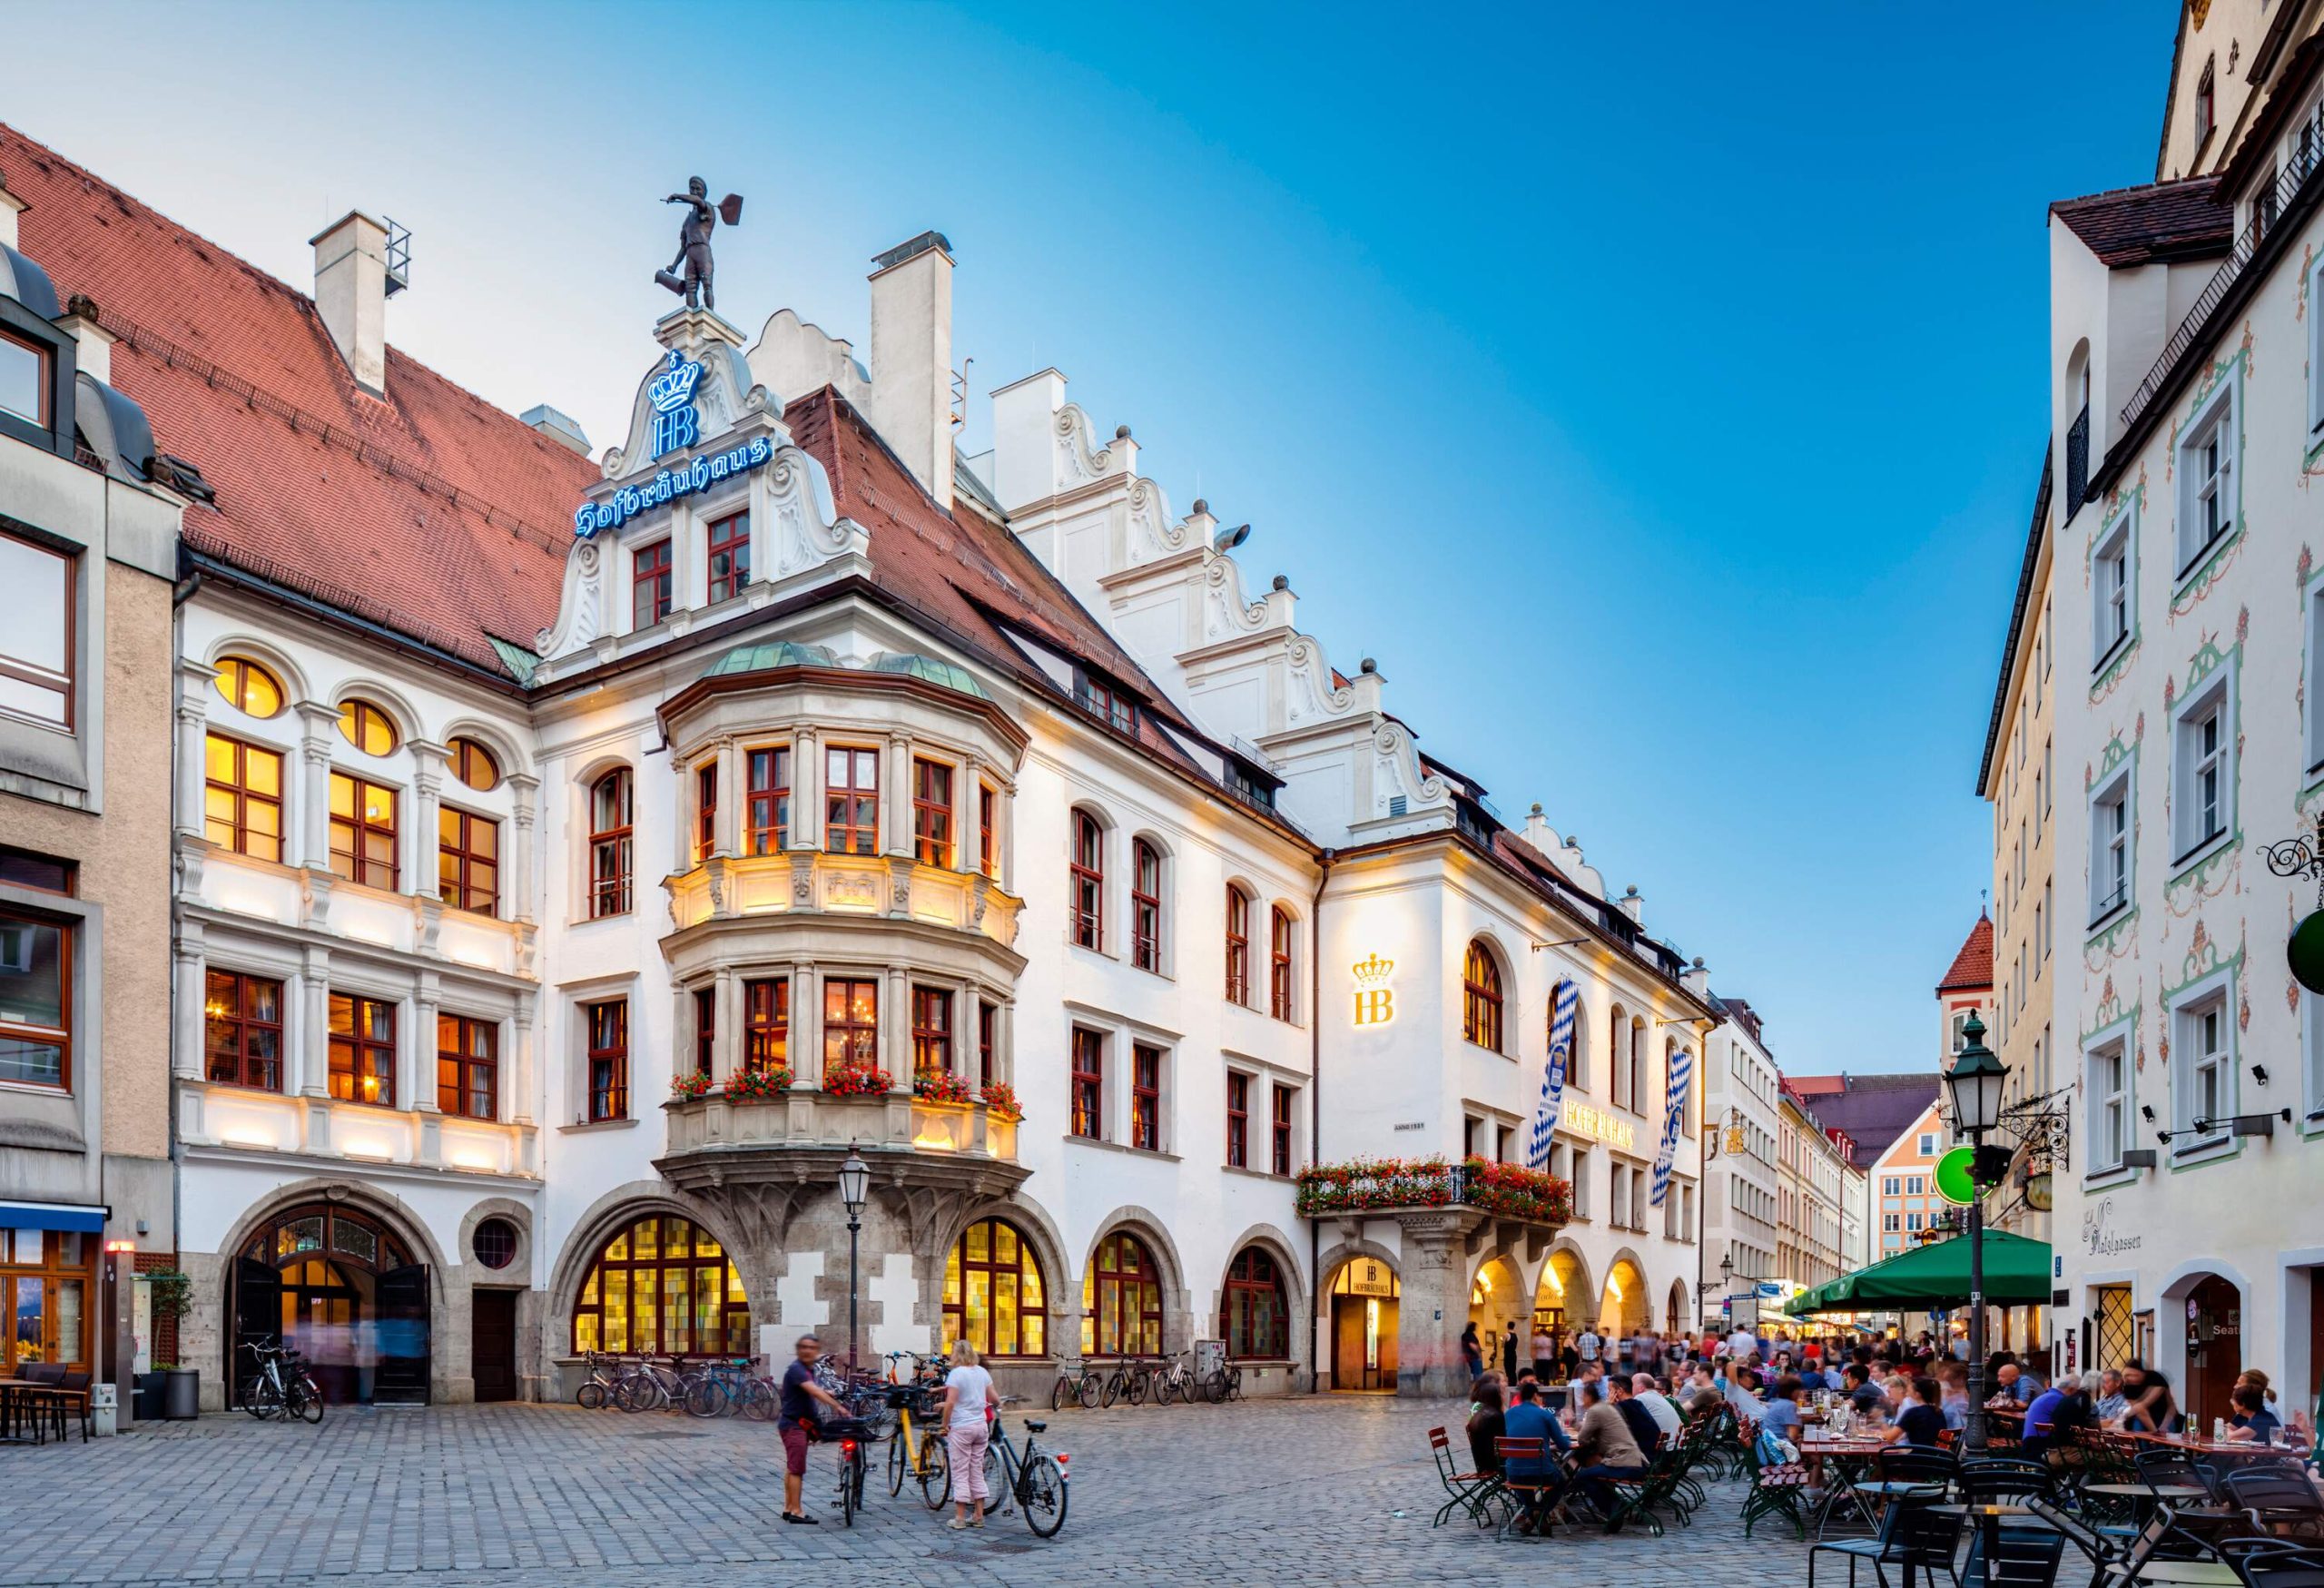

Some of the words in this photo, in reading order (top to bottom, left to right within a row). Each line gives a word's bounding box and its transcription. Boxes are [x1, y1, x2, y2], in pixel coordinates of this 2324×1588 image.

[652, 405, 696, 459] HB
[574, 437, 768, 537] Hofbräuhaus
[1354, 989, 1393, 1026] HB
[1566, 1100, 1634, 1149] HOFBRÄUHAUS
[1367, 1265, 1376, 1281] HB
[2212, 1325, 2240, 1336] Seat
